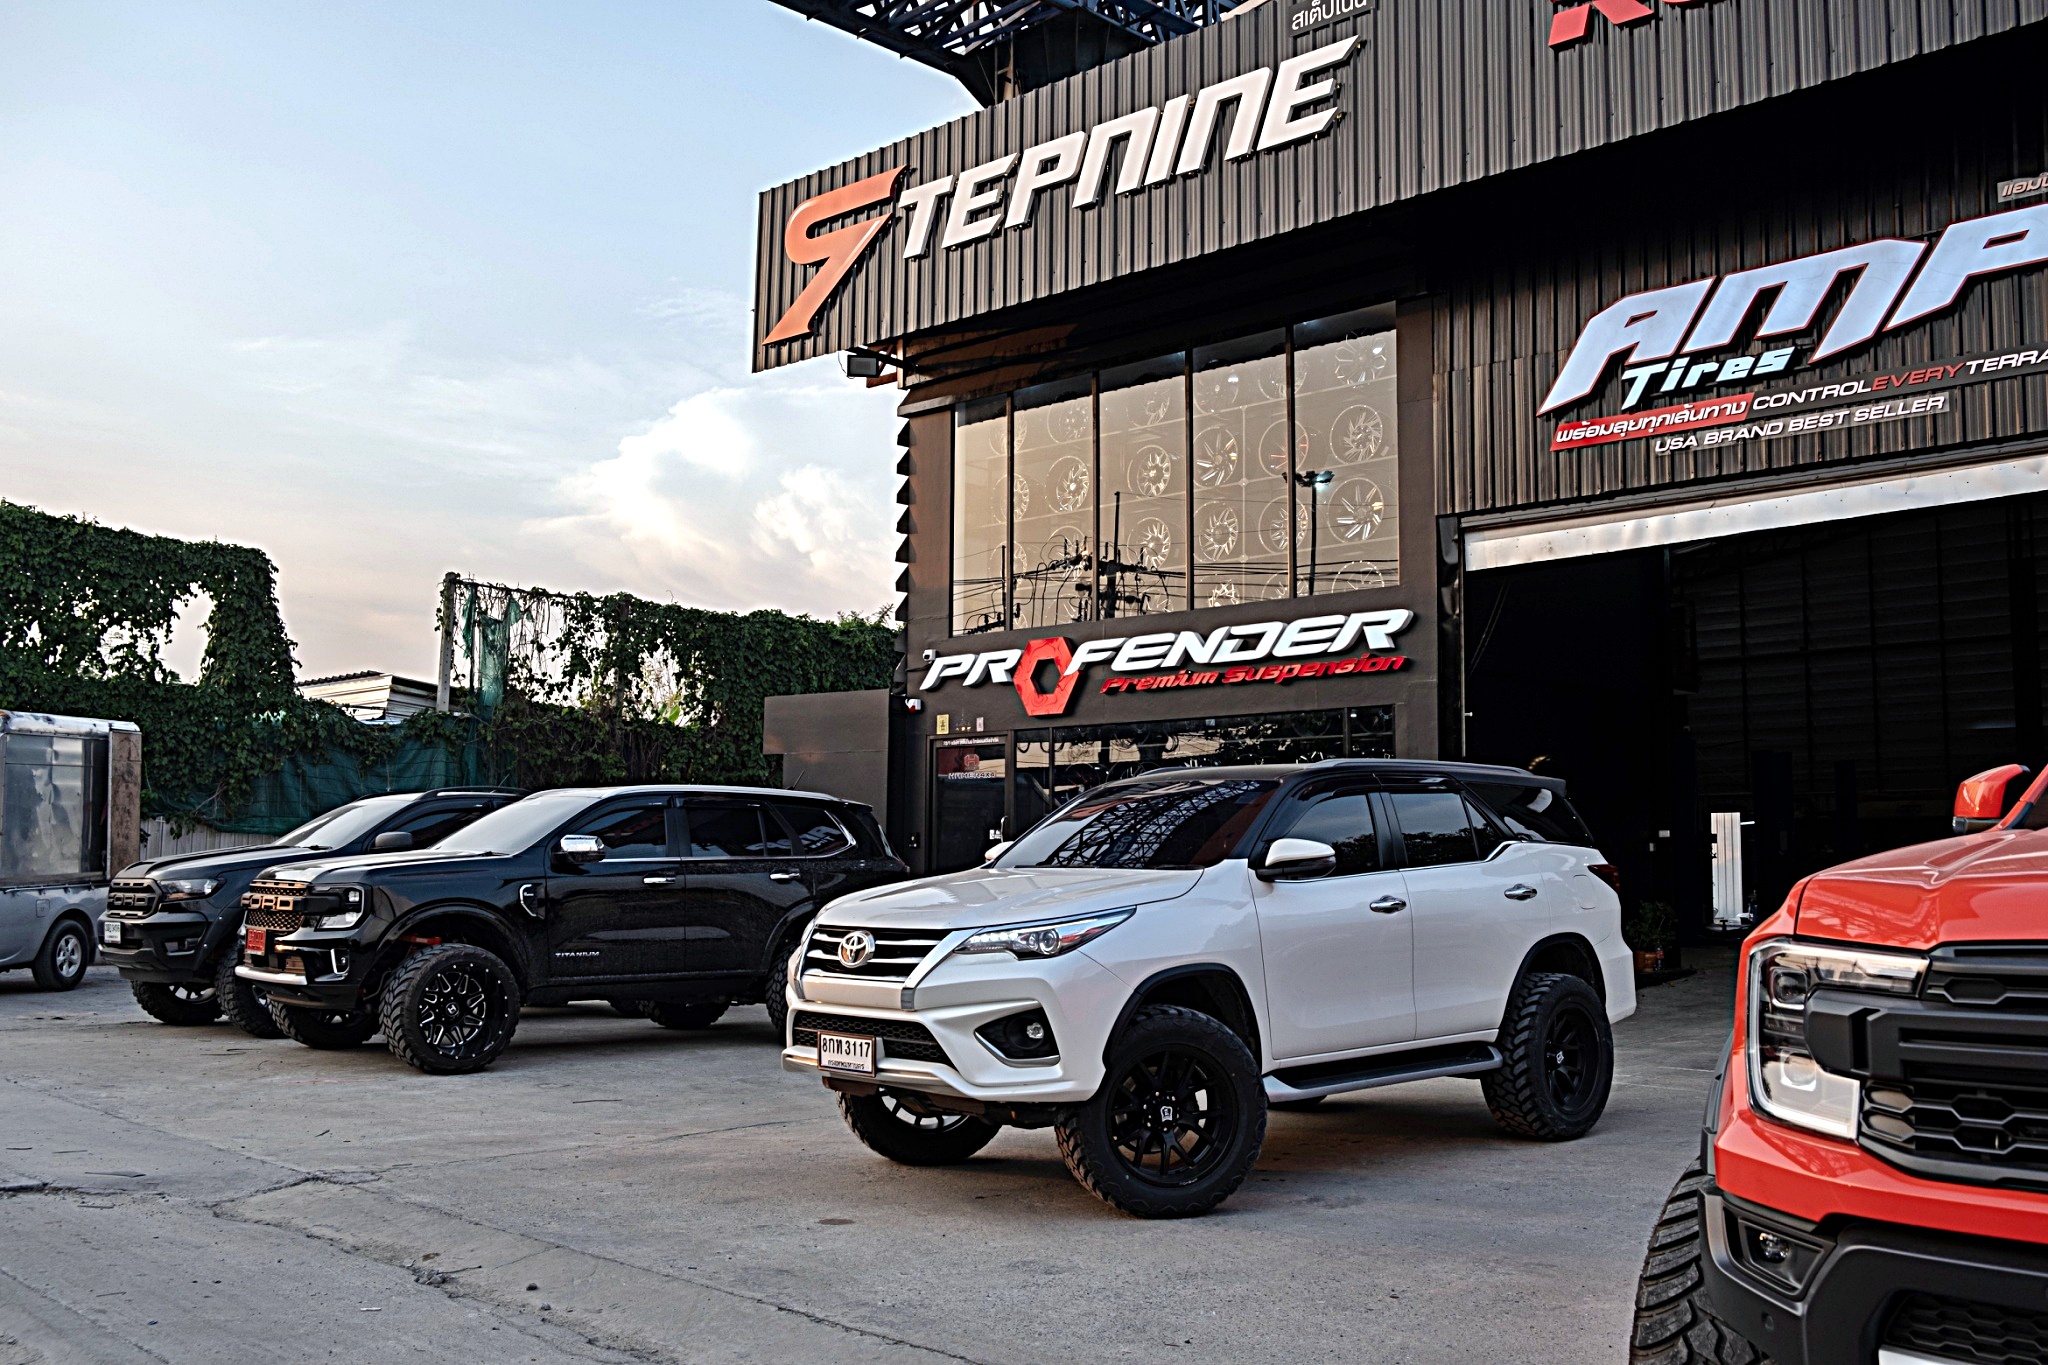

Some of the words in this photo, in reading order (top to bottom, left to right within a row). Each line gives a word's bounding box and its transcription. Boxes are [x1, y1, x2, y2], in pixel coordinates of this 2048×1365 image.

[1620, 346, 1796, 411] Tires
[1654, 436, 1699, 453] USA
[1703, 421, 1784, 446] BRAND
[1786, 411, 1851, 434] BEST
[1853, 396, 1945, 423] SELLER
[919, 607, 1414, 717] PROFENDER
[1099, 669, 1219, 694] Premium
[1221, 652, 1408, 685] Suspension
[844, 1039, 871, 1058] 3117
